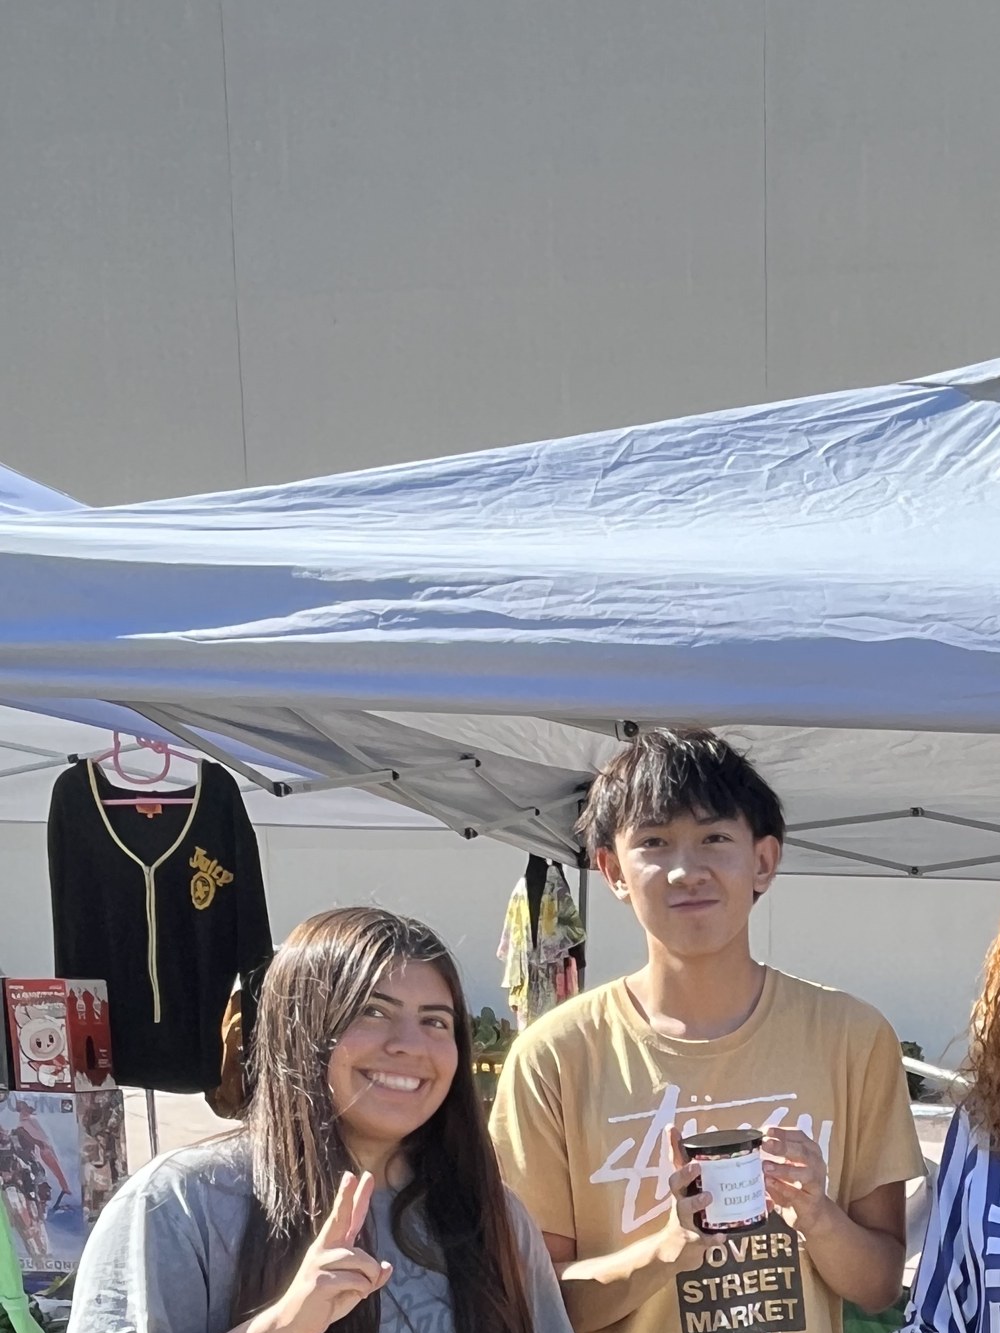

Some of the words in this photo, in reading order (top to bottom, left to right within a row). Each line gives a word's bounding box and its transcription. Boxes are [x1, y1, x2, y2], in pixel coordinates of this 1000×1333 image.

[189, 846, 234, 887] Juicy
[705, 1232, 793, 1268] OVER
[683, 1266, 796, 1303] STREET
